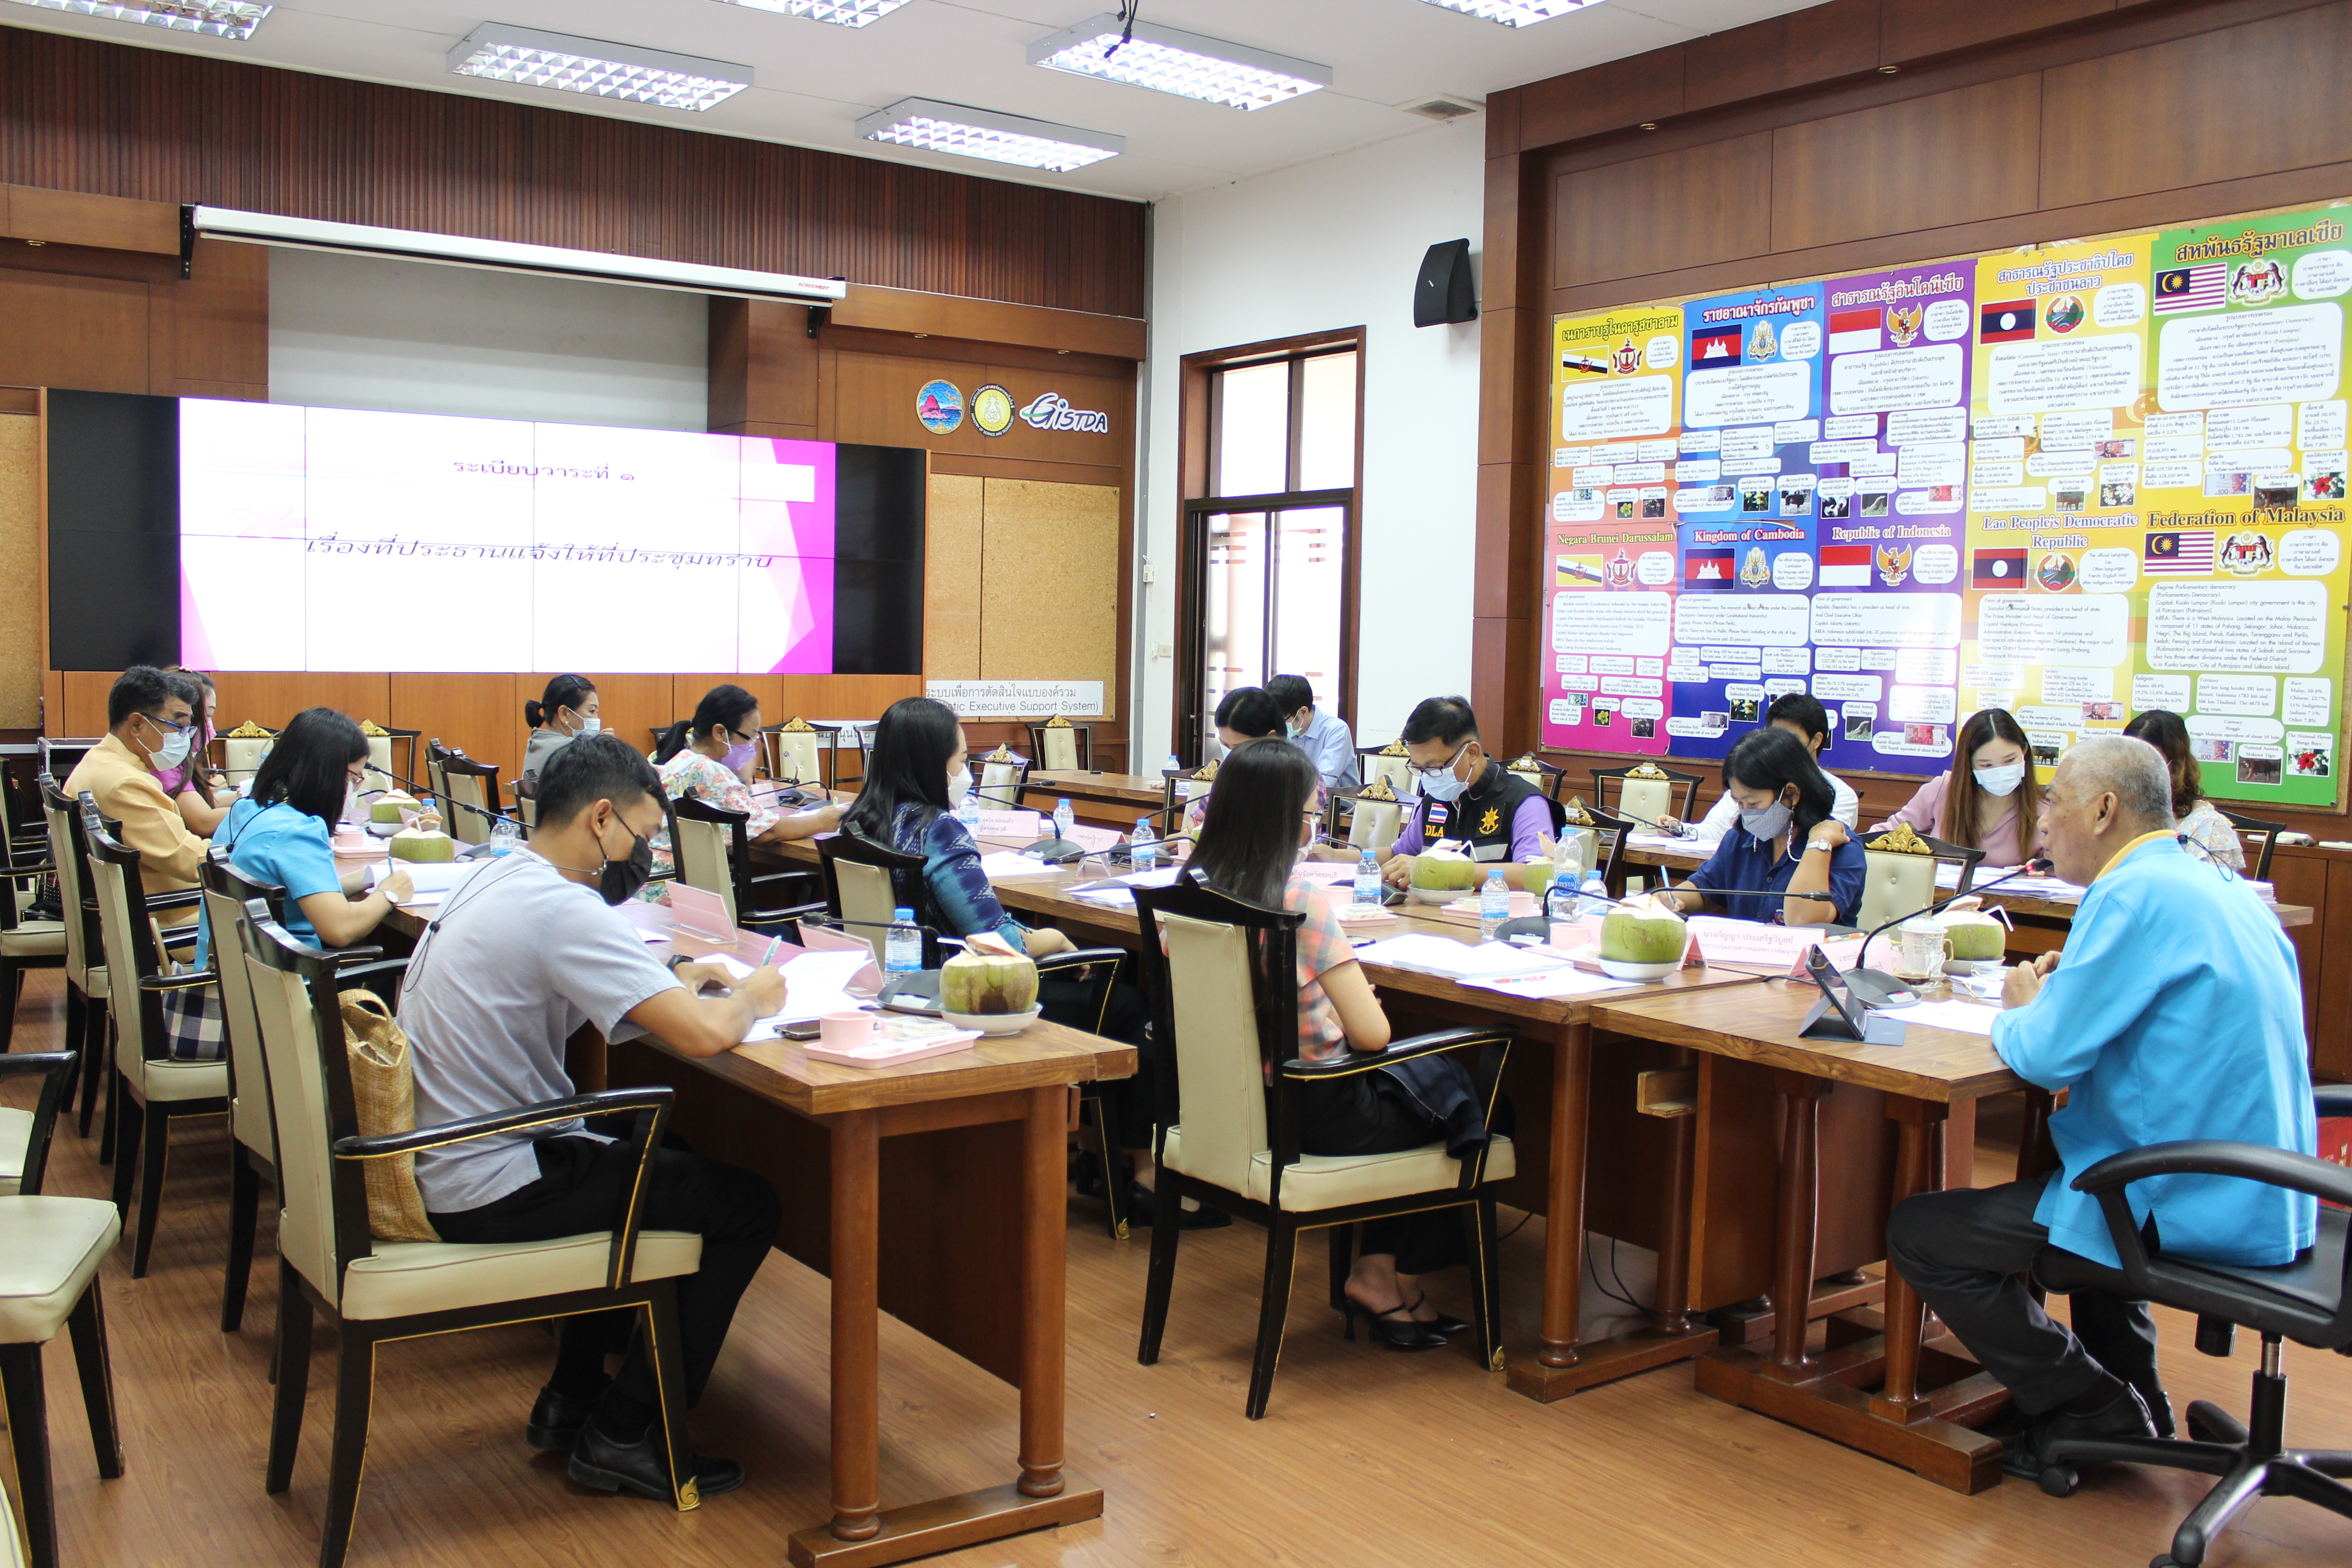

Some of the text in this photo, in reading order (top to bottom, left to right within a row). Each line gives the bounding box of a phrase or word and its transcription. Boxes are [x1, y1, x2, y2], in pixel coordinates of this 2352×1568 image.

[2176, 218, 2344, 262] สหพันธรัฐมาเลเซีย
[1997, 250, 2133, 283] สาธารณรัฐประชาธิปไตย
[1832, 273, 1964, 307] สาธารณรัฐอินโดนีเซีย
[2026, 275, 2102, 296] ประชาชนลาว
[1703, 296, 1814, 322] ราชอาณาจักรกัมพูชา
[453, 460, 610, 480] ระเบียบวาระที่
[1983, 512, 2139, 532] Lao People's Democratic
[2147, 505, 2346, 529] Federation of Malaysia
[1558, 532, 1673, 546] Negara Brunei Darussalam
[1694, 528, 1805, 544] Kingdom of Cambodia
[1833, 524, 1951, 542] Republic of Indonesia
[2031, 534, 2089, 551] Republic
[307, 532, 774, 570] เรื่องที่ประธานแจ้งให้ที่ประชุมทราบ
[926, 682, 1076, 698] ระบบเพื่อการตัดสินใจแบบองค์รวม
[969, 701, 1016, 711] Executive
[1019, 701, 1058, 713] Support
[1061, 701, 1099, 713] System)
[1425, 824, 1444, 838] DLA
